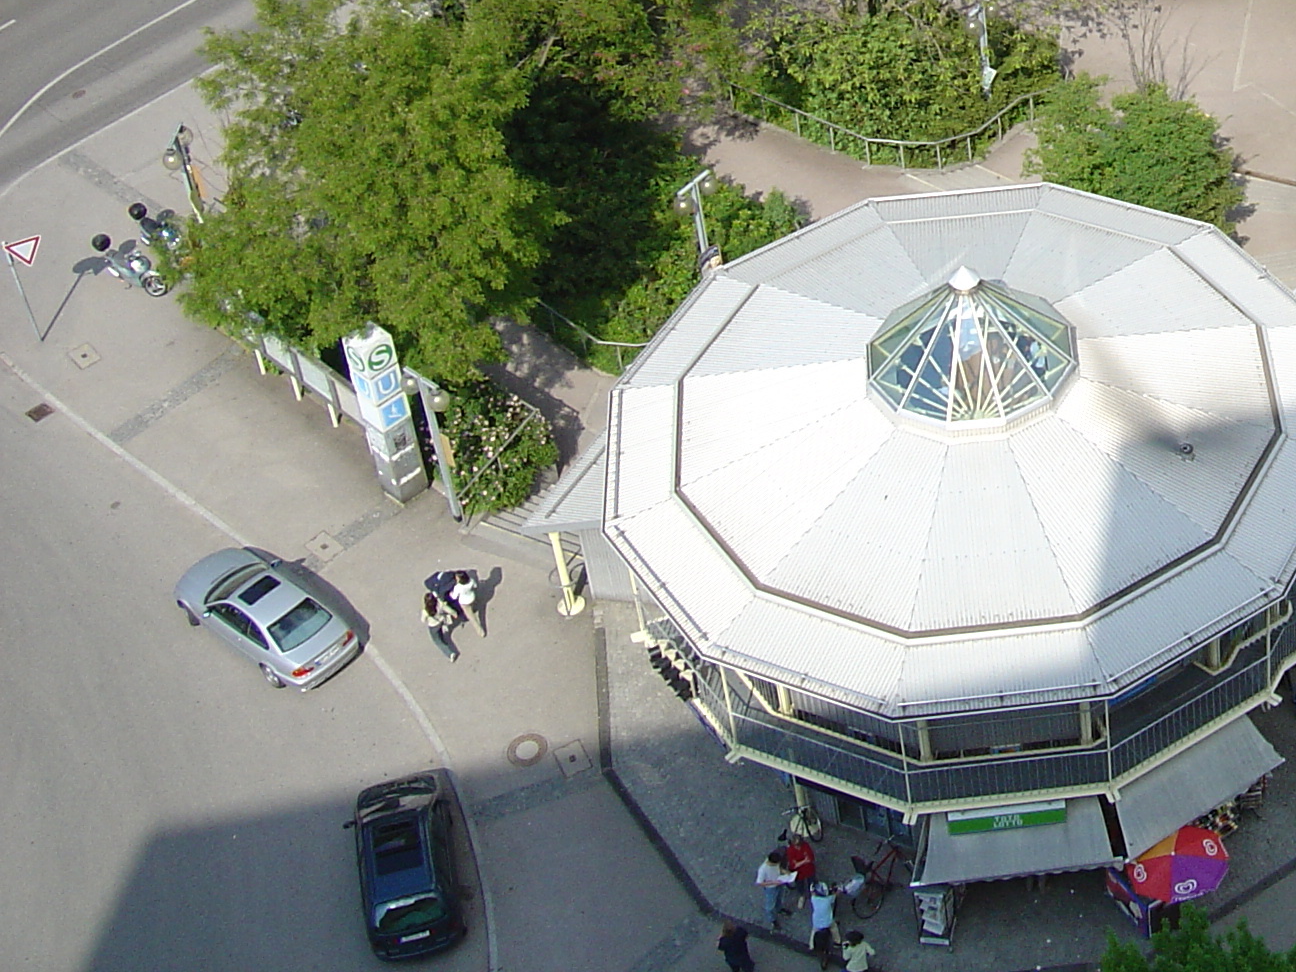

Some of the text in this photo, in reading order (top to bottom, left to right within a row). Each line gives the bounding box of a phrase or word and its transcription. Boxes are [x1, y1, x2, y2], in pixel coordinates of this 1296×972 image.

[369, 344, 392, 371] S
[378, 373, 396, 395] U
[993, 819, 1023, 829] LOTTO
